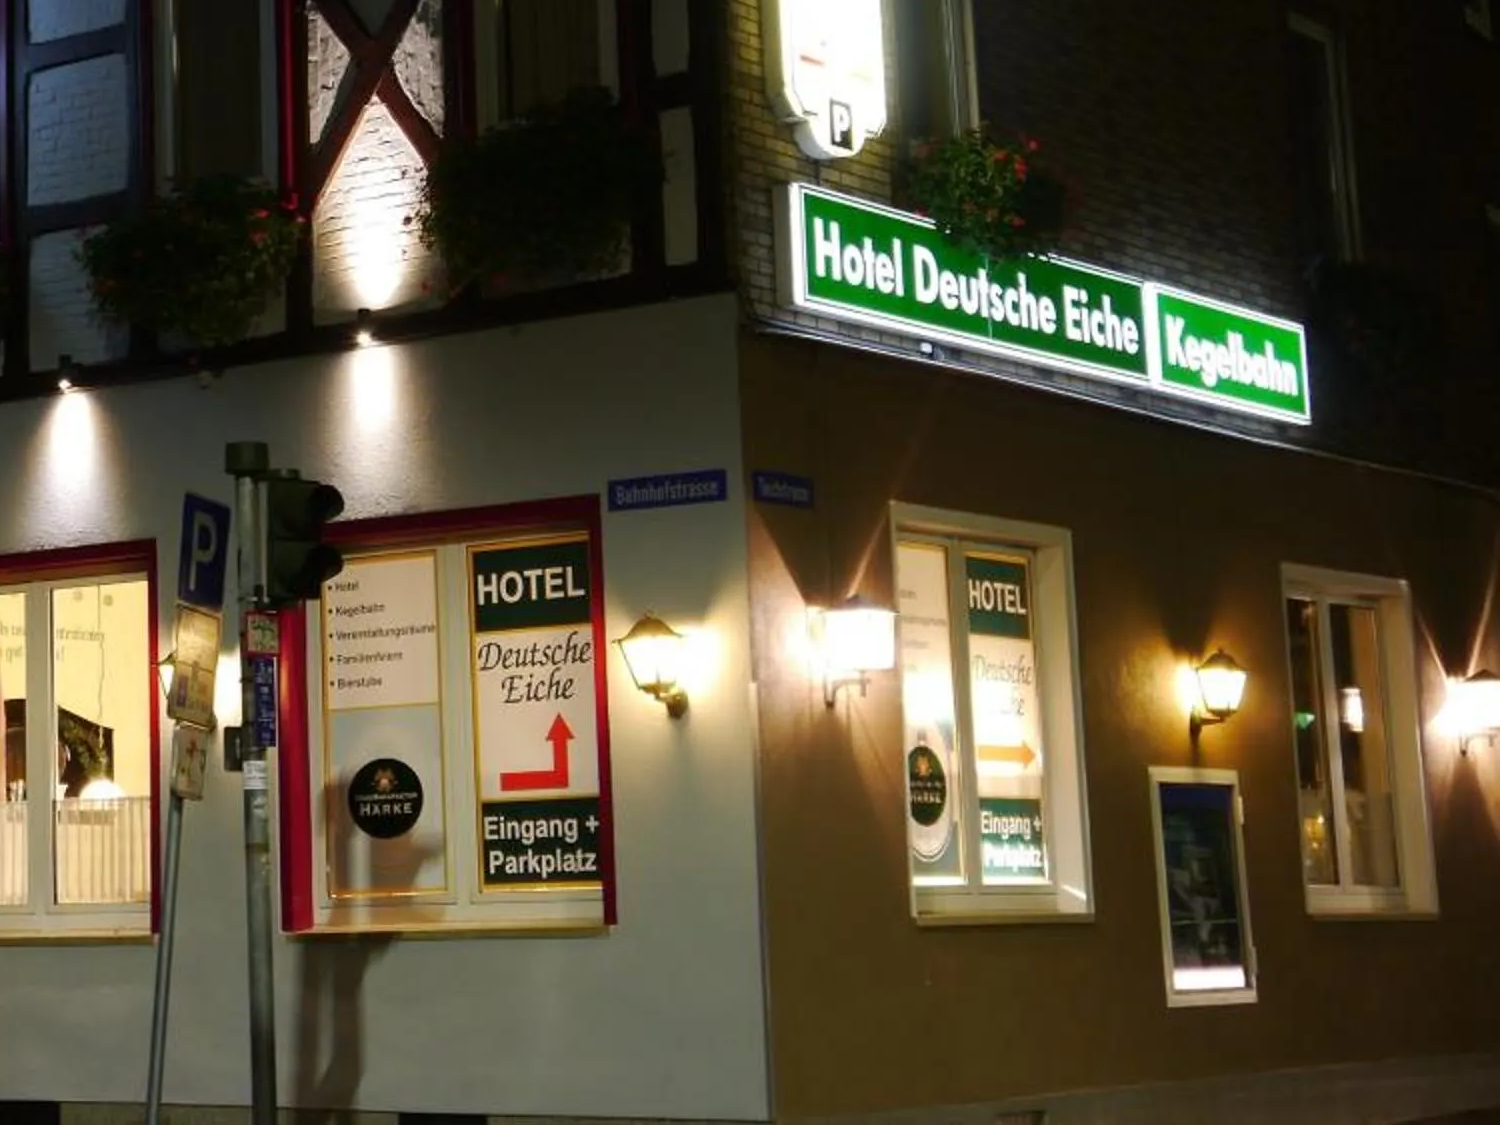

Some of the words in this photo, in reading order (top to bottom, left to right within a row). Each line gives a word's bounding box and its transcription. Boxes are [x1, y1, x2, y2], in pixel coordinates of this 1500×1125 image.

[812, 216, 905, 297] Hotel
[912, 243, 1057, 334] Deutsche
[1061, 284, 1140, 354] Eiche
[1164, 313, 1299, 397] Kegelbahn
[188, 510, 218, 591] P
[477, 566, 585, 606] HOTEL
[969, 579, 1027, 615] HOTEL
[478, 631, 592, 672] Deutsche
[501, 667, 575, 704] Eiche
[483, 816, 578, 845] Eingang
[981, 810, 1031, 840] Eingang
[489, 848, 597, 879] Parkplatz
